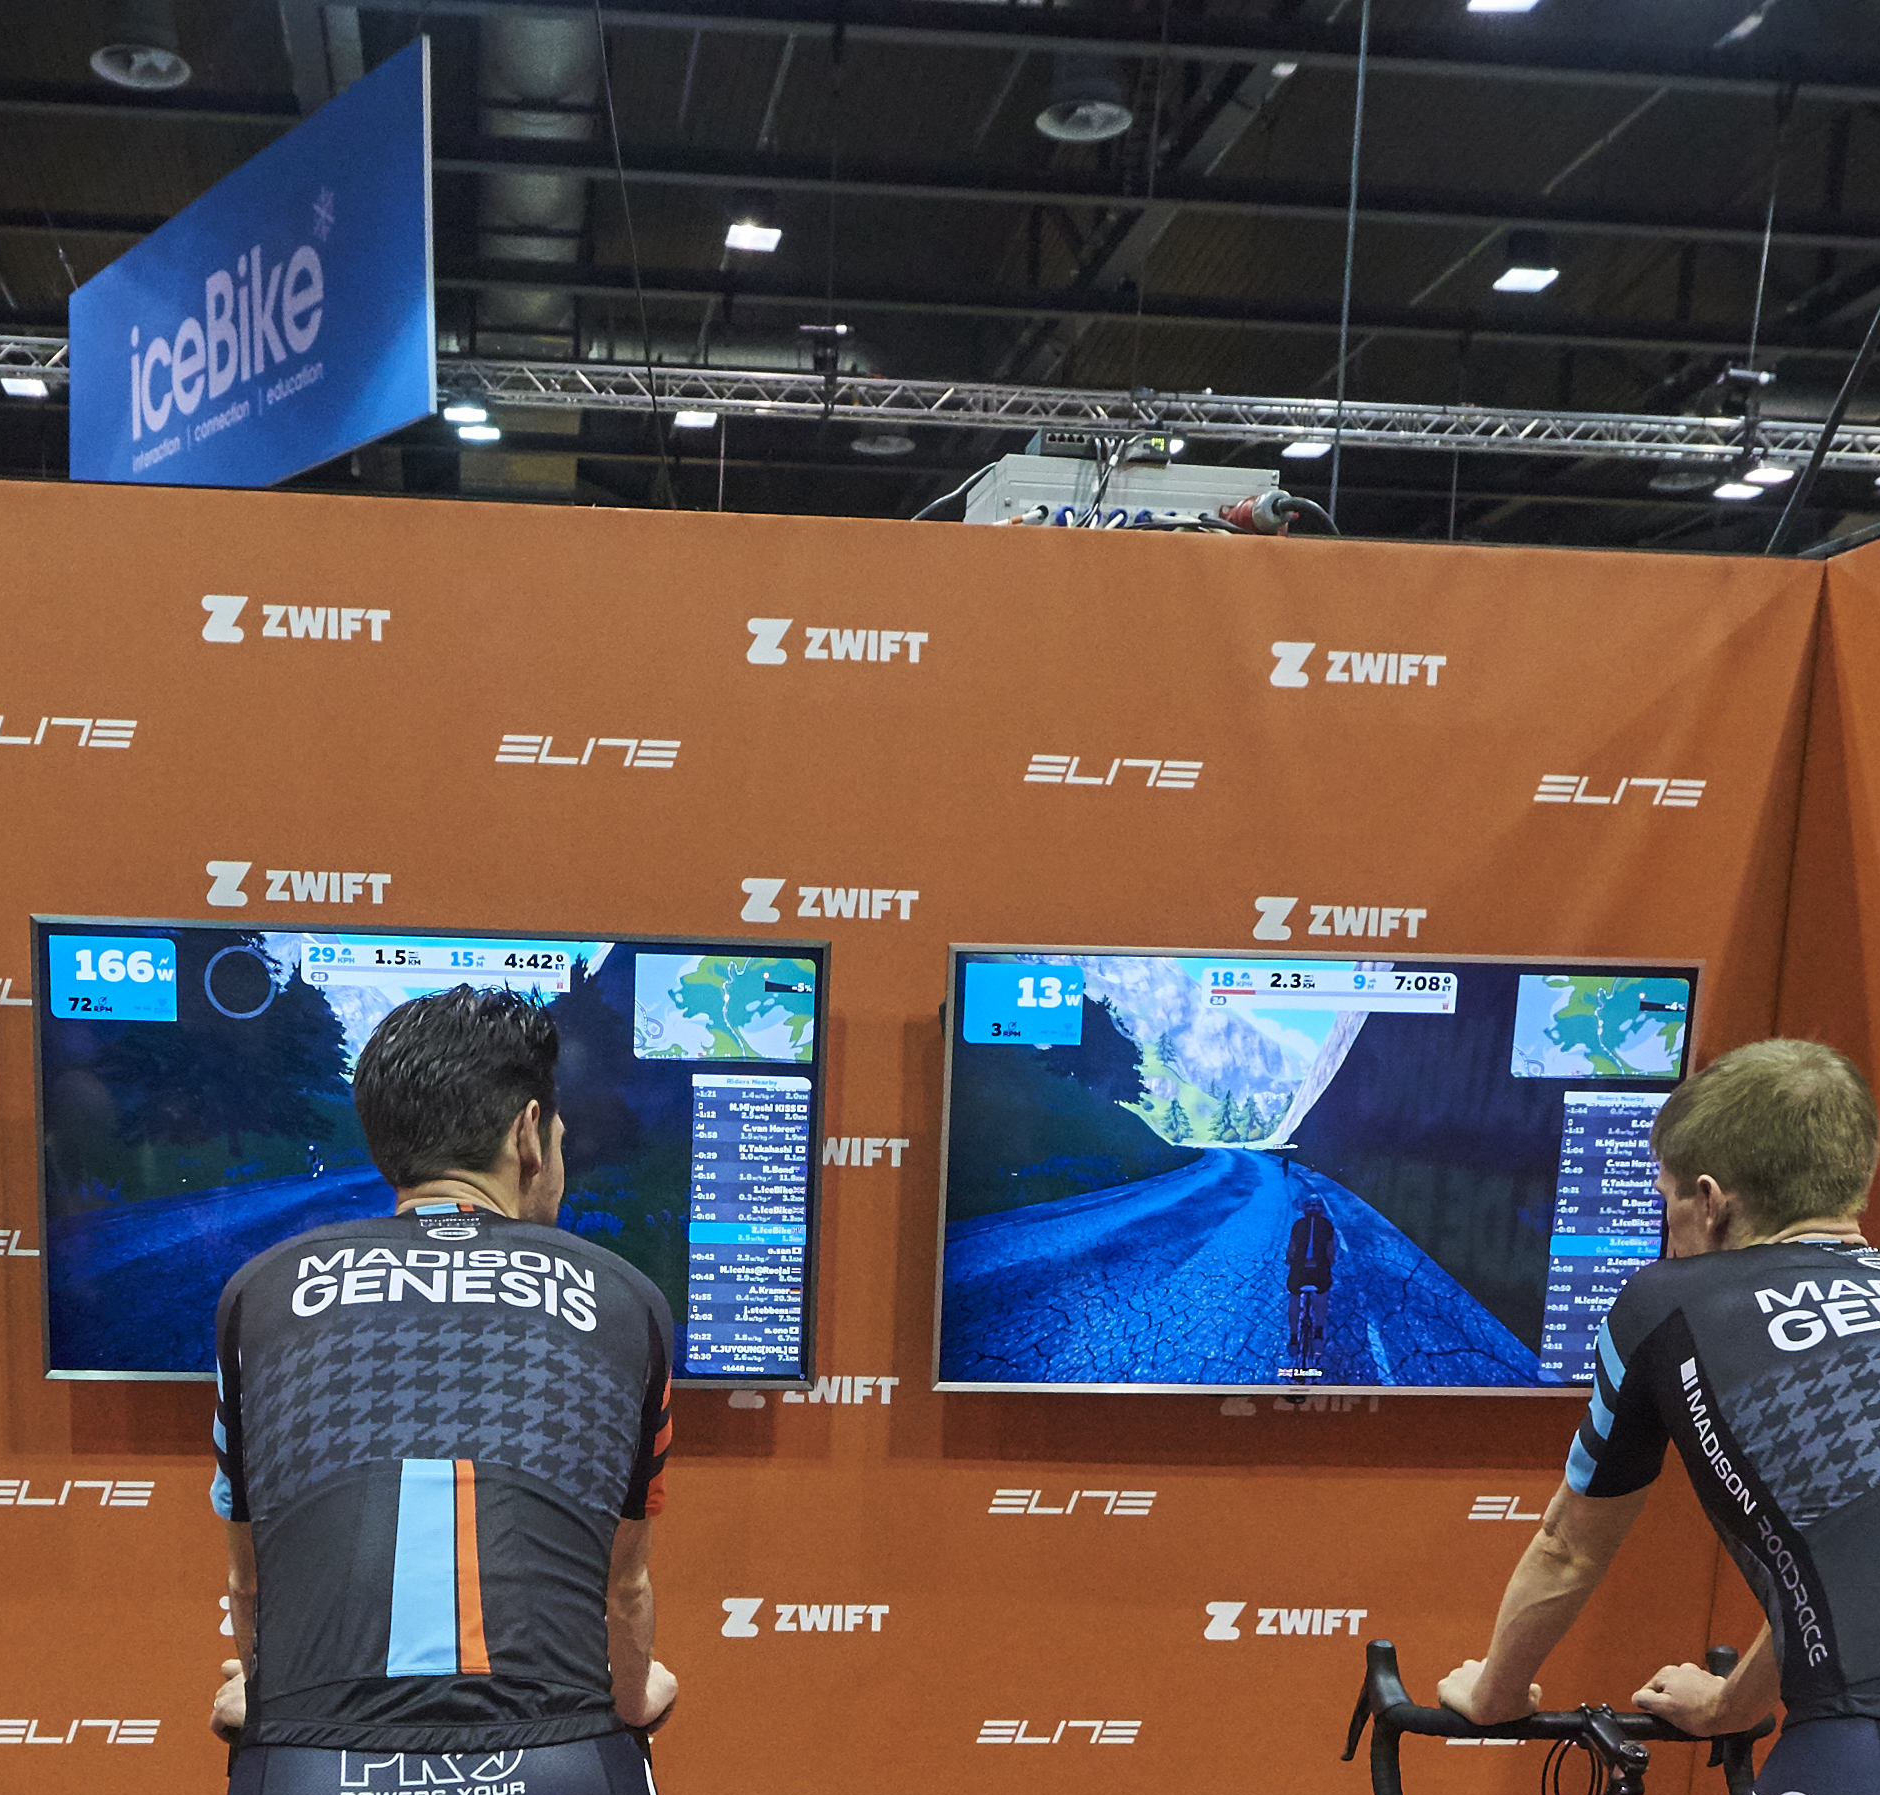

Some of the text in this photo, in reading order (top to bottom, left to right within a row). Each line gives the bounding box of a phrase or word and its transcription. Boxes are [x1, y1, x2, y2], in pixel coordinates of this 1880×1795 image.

[131, 245, 324, 442] iceBike
[132, 362, 324, 472] interaction connection education
[262, 605, 390, 642] ZWIFT
[804, 628, 928, 663] ZWIFT
[1326, 652, 1446, 686] ZWIFT
[495, 735, 680, 768] ELITE
[1024, 755, 1203, 789] ELITE
[1534, 775, 1705, 807] ELITE
[266, 870, 391, 904] ZWIFT
[798, 887, 919, 920] ZWIFT
[1308, 906, 1427, 938] ZWIFT
[75, 948, 155, 982] 166
[308, 946, 553, 970] 29 KPH 1.5 15 4:42
[1017, 977, 1063, 1008] 13
[1211, 971, 1234, 987] 18
[1270, 973, 1302, 989] 2.3
[1353, 974, 1365, 990] 9
[1394, 976, 1440, 992] 7:08
[68, 997, 113, 1013] 72 RPM
[991, 1022, 1021, 1038] 3 RPM
[823, 1138, 909, 1167] WIFT
[298, 1248, 595, 1293] MADISON
[291, 1266, 599, 1332] GENESIS
[1687, 1393, 1757, 1515] MADISON
[989, 1490, 1156, 1515] ELITE
[775, 1605, 889, 1631] ZWIFT
[1256, 1609, 1367, 1635] ZWIFT
[977, 1721, 1141, 1743] ELITE
